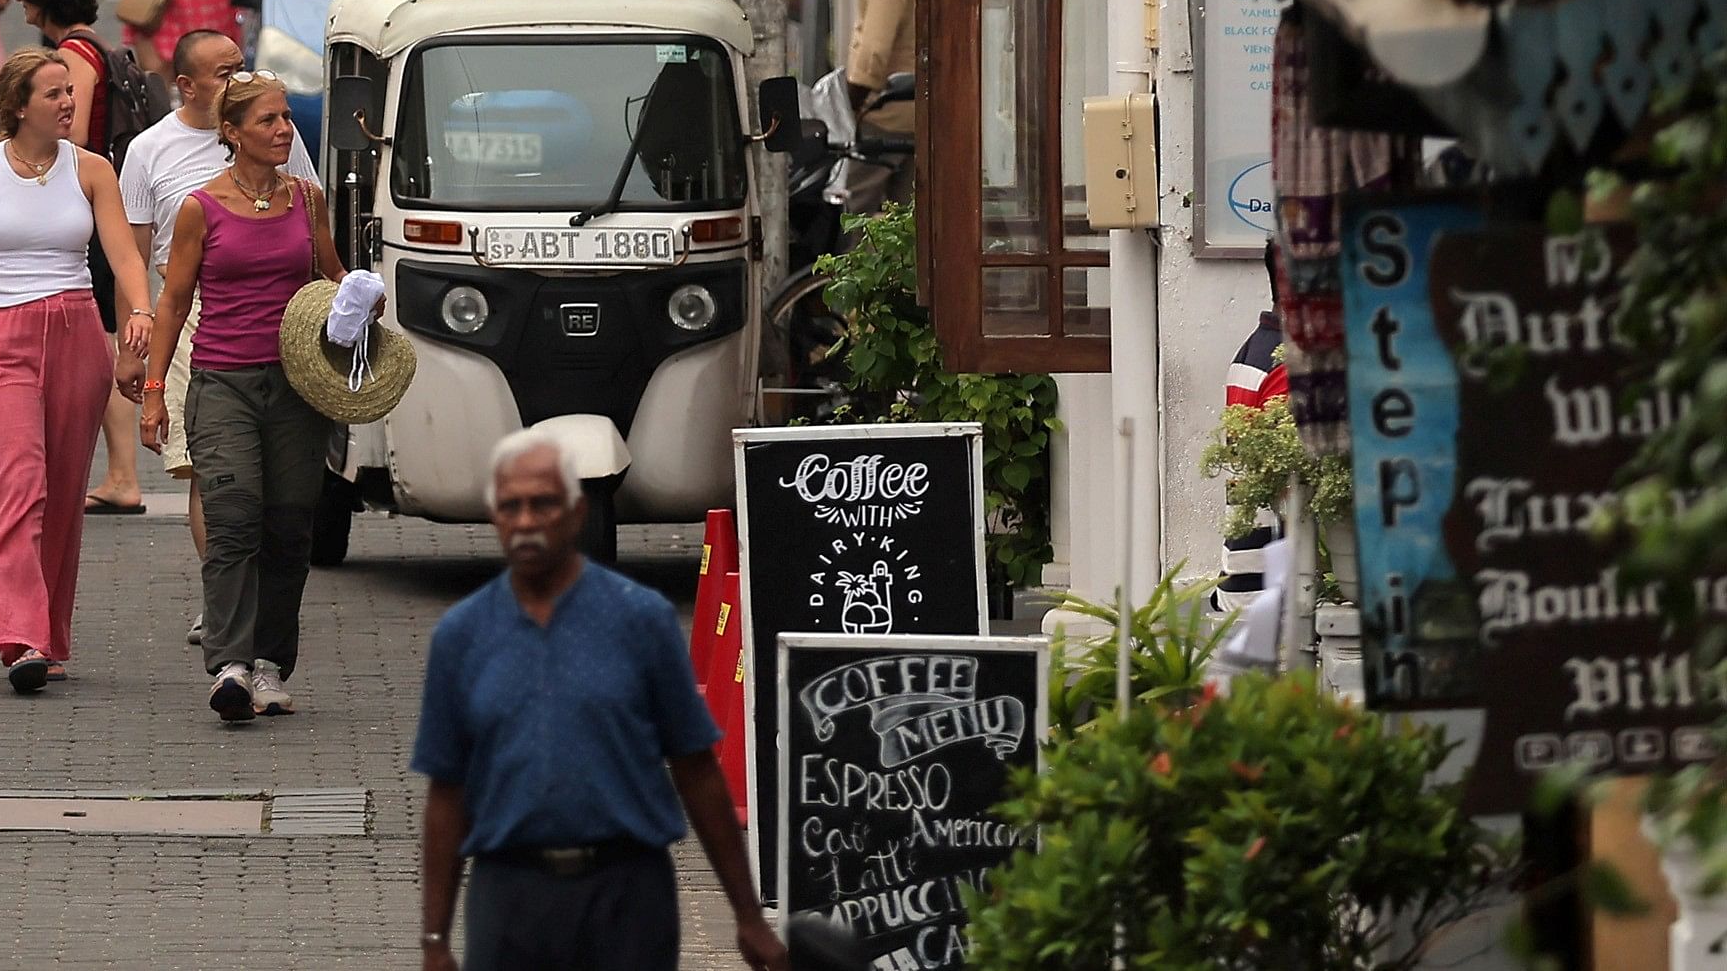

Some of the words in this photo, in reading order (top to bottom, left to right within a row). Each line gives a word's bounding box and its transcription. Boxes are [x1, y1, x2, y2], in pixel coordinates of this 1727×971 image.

[1224, 26, 1258, 37] BLACK
[490, 244, 515, 260] SP
[521, 232, 580, 259] ABT
[594, 232, 671, 259] 1880
[568, 314, 594, 329] RE
[1361, 214, 1421, 527] Step
[778, 453, 930, 503] Coffee
[839, 504, 893, 528] WITH
[809, 531, 866, 607] DAIRY
[879, 535, 923, 604] KING
[815, 656, 976, 715] COFFEE
[896, 698, 1005, 759] MENU
[801, 753, 952, 811] ESPRESSO
